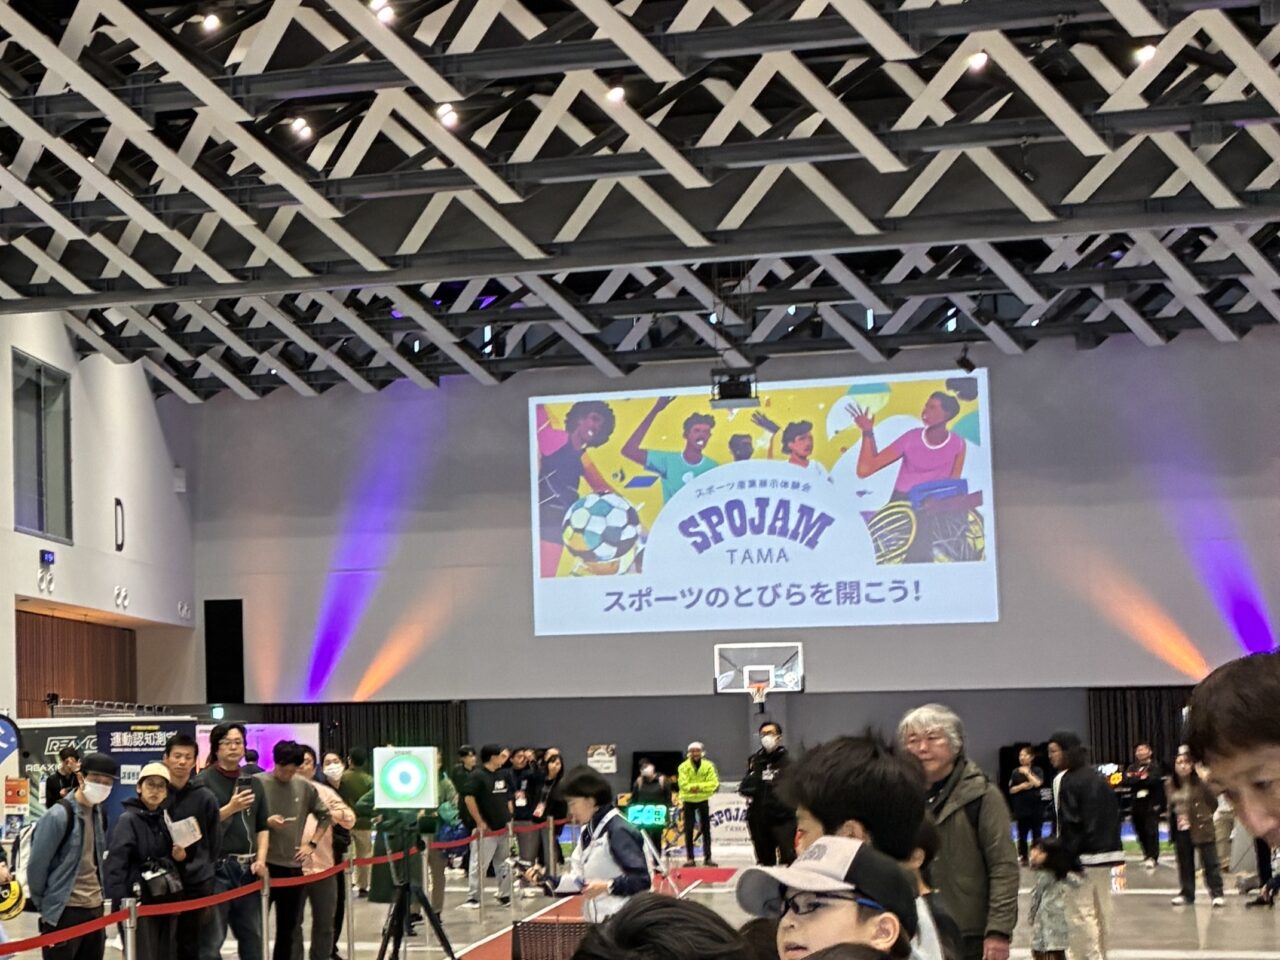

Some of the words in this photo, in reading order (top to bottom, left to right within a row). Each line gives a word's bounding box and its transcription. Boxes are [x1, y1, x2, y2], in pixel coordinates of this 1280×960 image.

[114, 497, 125, 552] D
[678, 497, 835, 554] SPOJAM
[726, 548, 790, 565] TAMA
